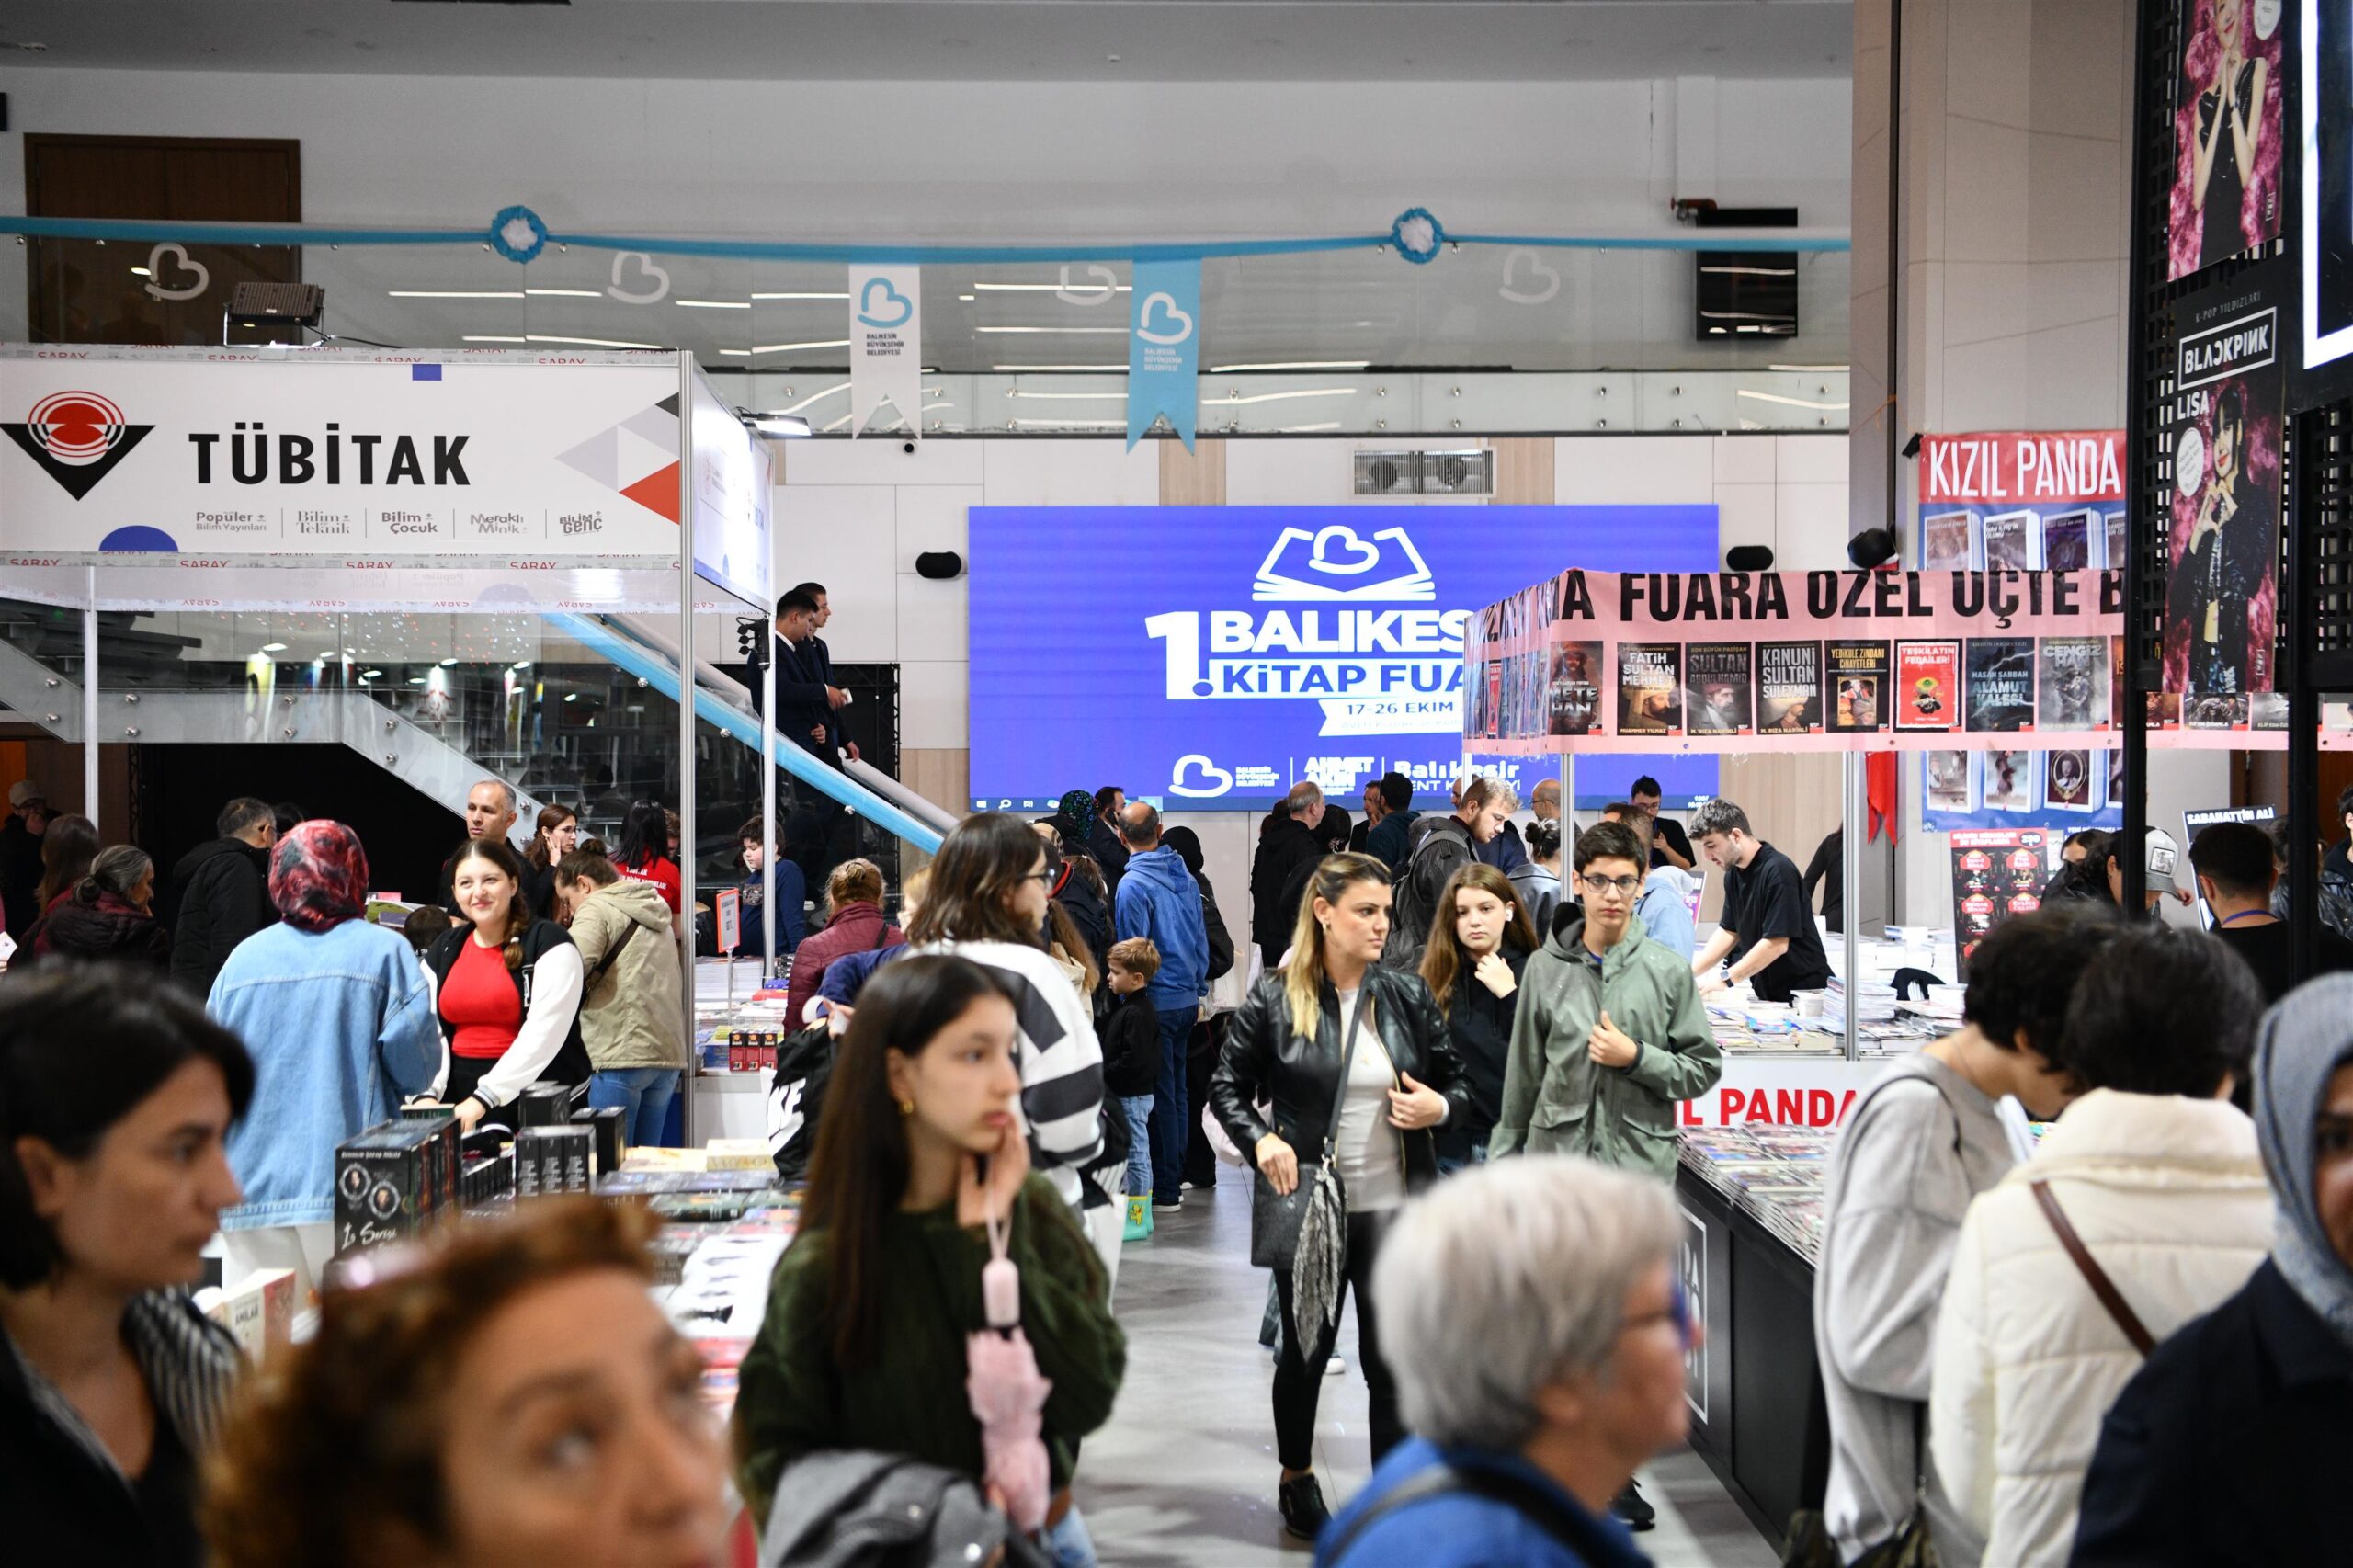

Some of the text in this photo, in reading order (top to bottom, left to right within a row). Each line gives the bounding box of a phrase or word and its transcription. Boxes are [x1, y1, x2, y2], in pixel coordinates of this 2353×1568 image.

[2184, 324, 2269, 374] BLACKPINK
[2177, 390, 2210, 420] LISA
[188, 422, 472, 485] TÜBİTAK
[1930, 440, 2006, 497] KIZIL
[2018, 438, 2121, 497] PANDA
[196, 511, 253, 525] Popüler
[381, 511, 421, 523] Bilim
[196, 523, 267, 533] Bilim Yayınları
[390, 522, 438, 534] Çocuk
[478, 523, 520, 534] Minik
[1620, 572, 1789, 622] FUARA
[1623, 665, 1674, 675] SULTAN
[1690, 654, 1747, 672] SULTAN
[1622, 676, 1675, 686] MEHMET
[1763, 666, 1815, 684] SULTAN
[1972, 680, 2029, 693] ALAMUT
[1346, 704, 1398, 715] 17-26
[1551, 701, 1592, 716] HAN
